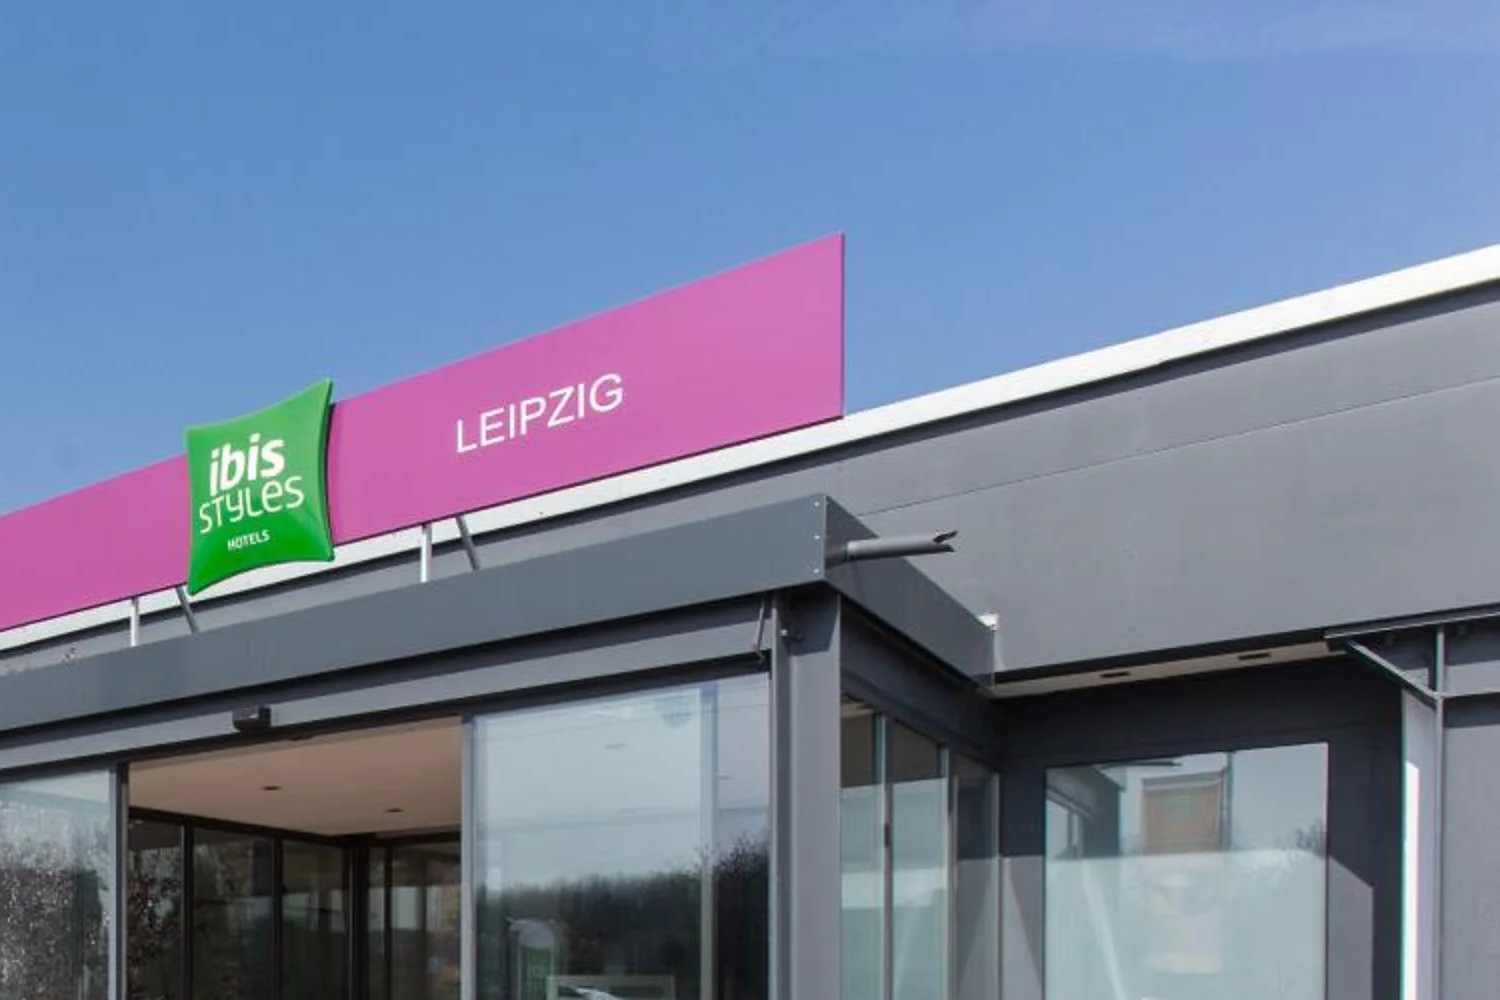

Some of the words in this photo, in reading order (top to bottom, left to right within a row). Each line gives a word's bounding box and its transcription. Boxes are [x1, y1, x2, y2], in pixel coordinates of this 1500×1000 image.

[455, 373, 624, 453] LEIPZIG
[209, 433, 285, 496] ibis
[227, 529, 270, 551] HOTELS
